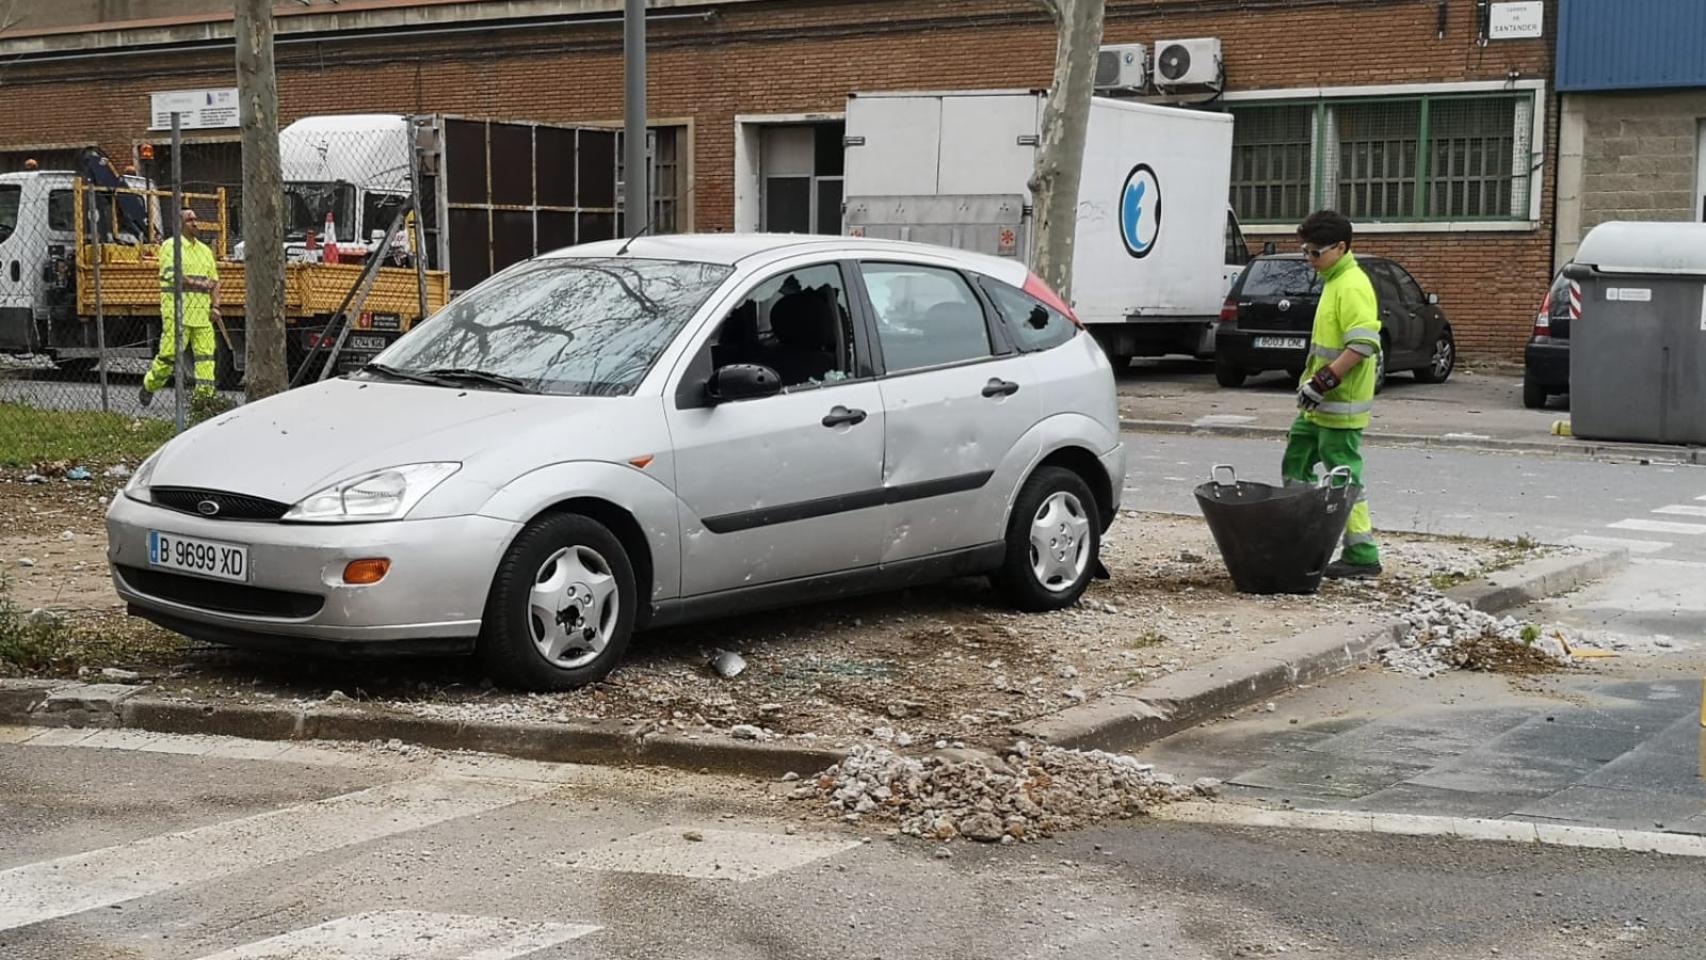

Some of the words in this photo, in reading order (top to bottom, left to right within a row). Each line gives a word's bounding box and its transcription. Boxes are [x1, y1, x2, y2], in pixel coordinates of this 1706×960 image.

[1494, 24, 1537, 32] SANTANDER
[160, 537, 169, 563] B
[175, 540, 216, 571] 9699
[221, 547, 243, 576] XD
